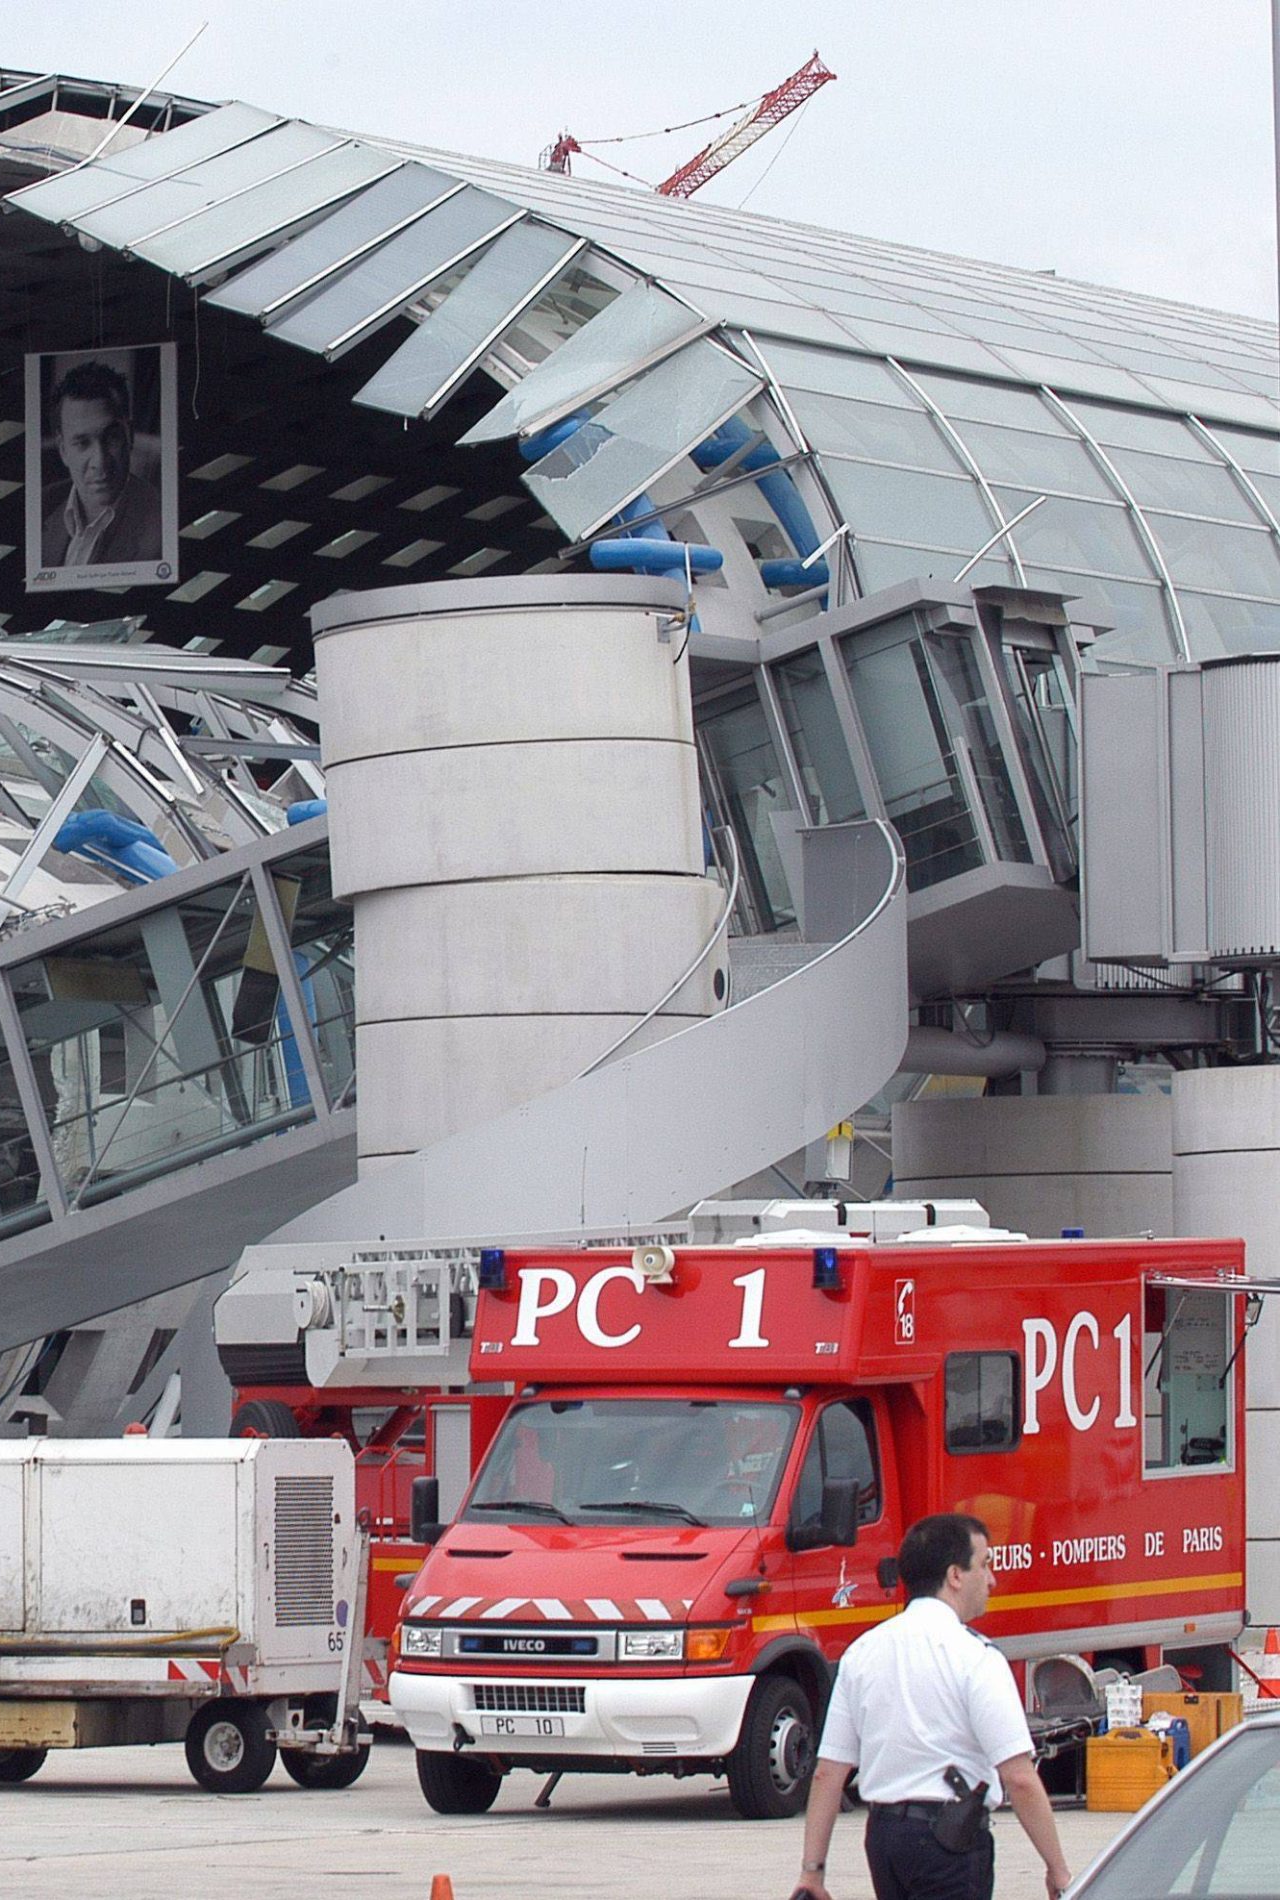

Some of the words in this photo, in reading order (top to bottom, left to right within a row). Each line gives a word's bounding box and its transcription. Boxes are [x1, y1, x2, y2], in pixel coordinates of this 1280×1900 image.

[510, 1266, 645, 1348] PC
[728, 1268, 769, 1348] 1
[900, 1313, 914, 1338] 18
[1053, 1534, 1126, 1566] POMPIERS
[1145, 1532, 1165, 1557] DE
[1183, 1526, 1223, 1554] PARIS
[503, 1639, 545, 1651] IVECO
[496, 1718, 515, 1734] PC
[536, 1719, 553, 1735] 10
